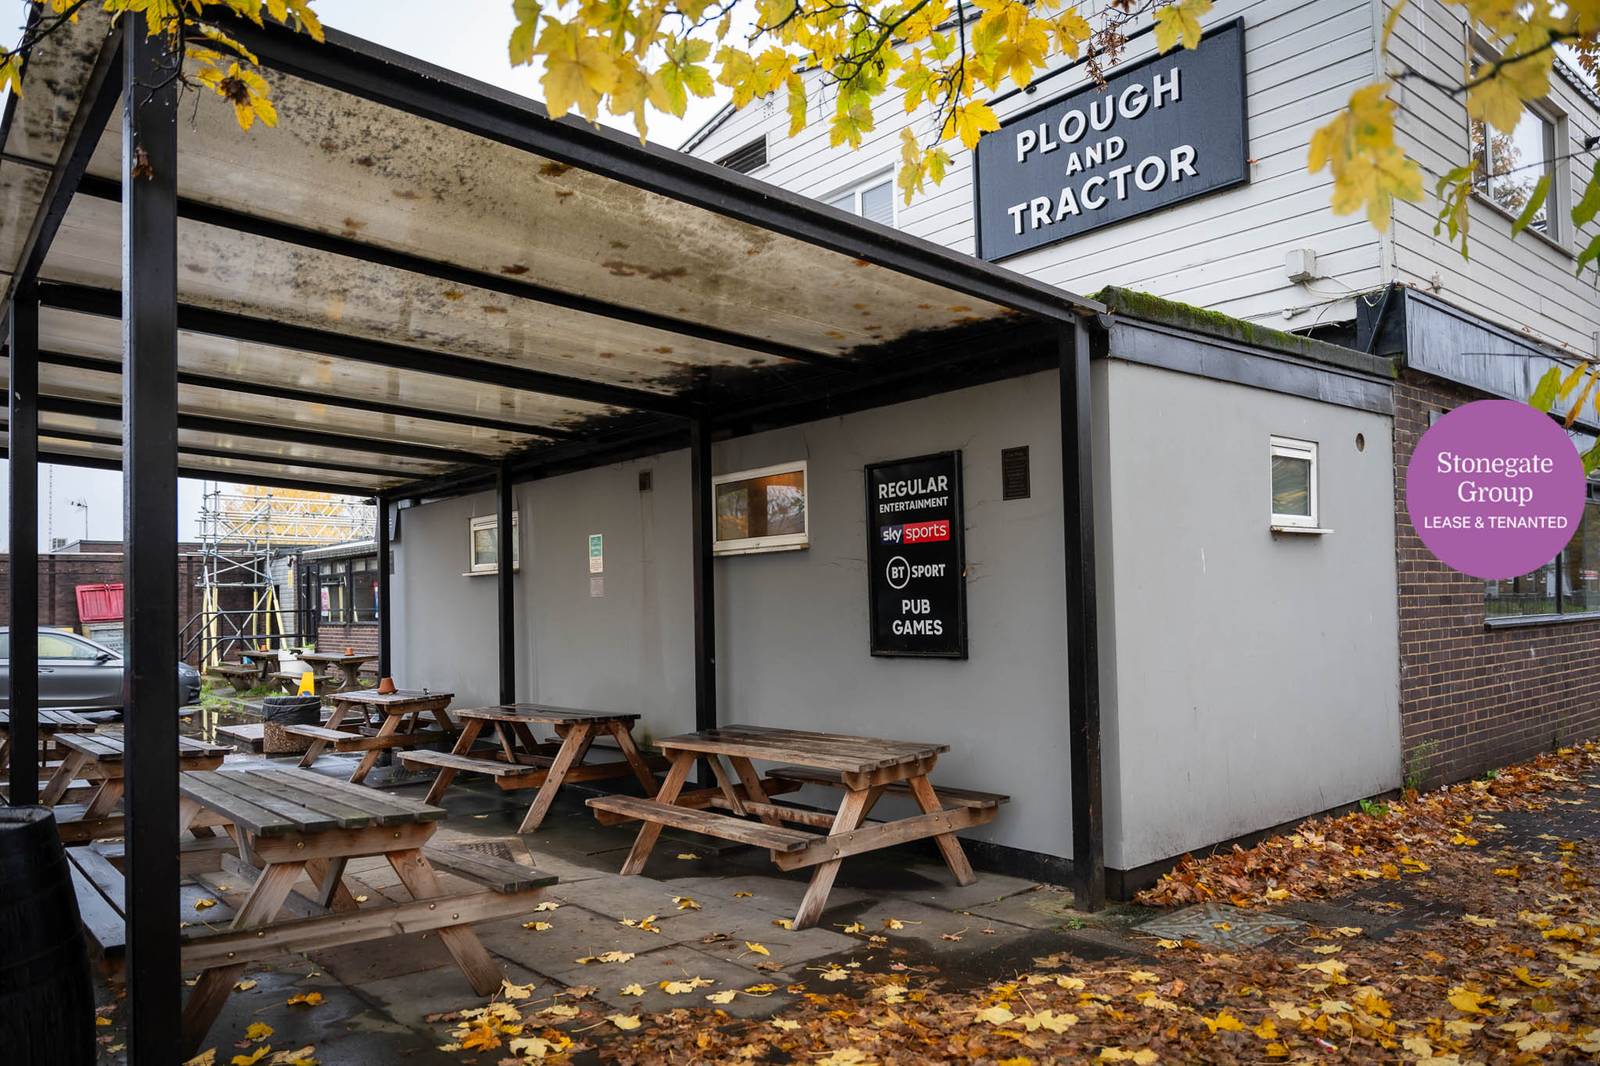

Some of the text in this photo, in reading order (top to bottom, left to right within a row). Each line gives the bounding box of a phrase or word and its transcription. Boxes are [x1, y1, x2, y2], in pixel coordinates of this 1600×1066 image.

[1016, 67, 1181, 162] PLOUGH
[1065, 136, 1125, 176] AND
[1007, 144, 1198, 234] TRACTOR
[878, 475, 949, 500] REGULAR
[879, 496, 949, 514] ENTERTAINMENT
[882, 523, 947, 545] sky sports
[891, 563, 946, 579] BT SPORT
[902, 599, 931, 615] PUB
[892, 619, 943, 636] GAMES
